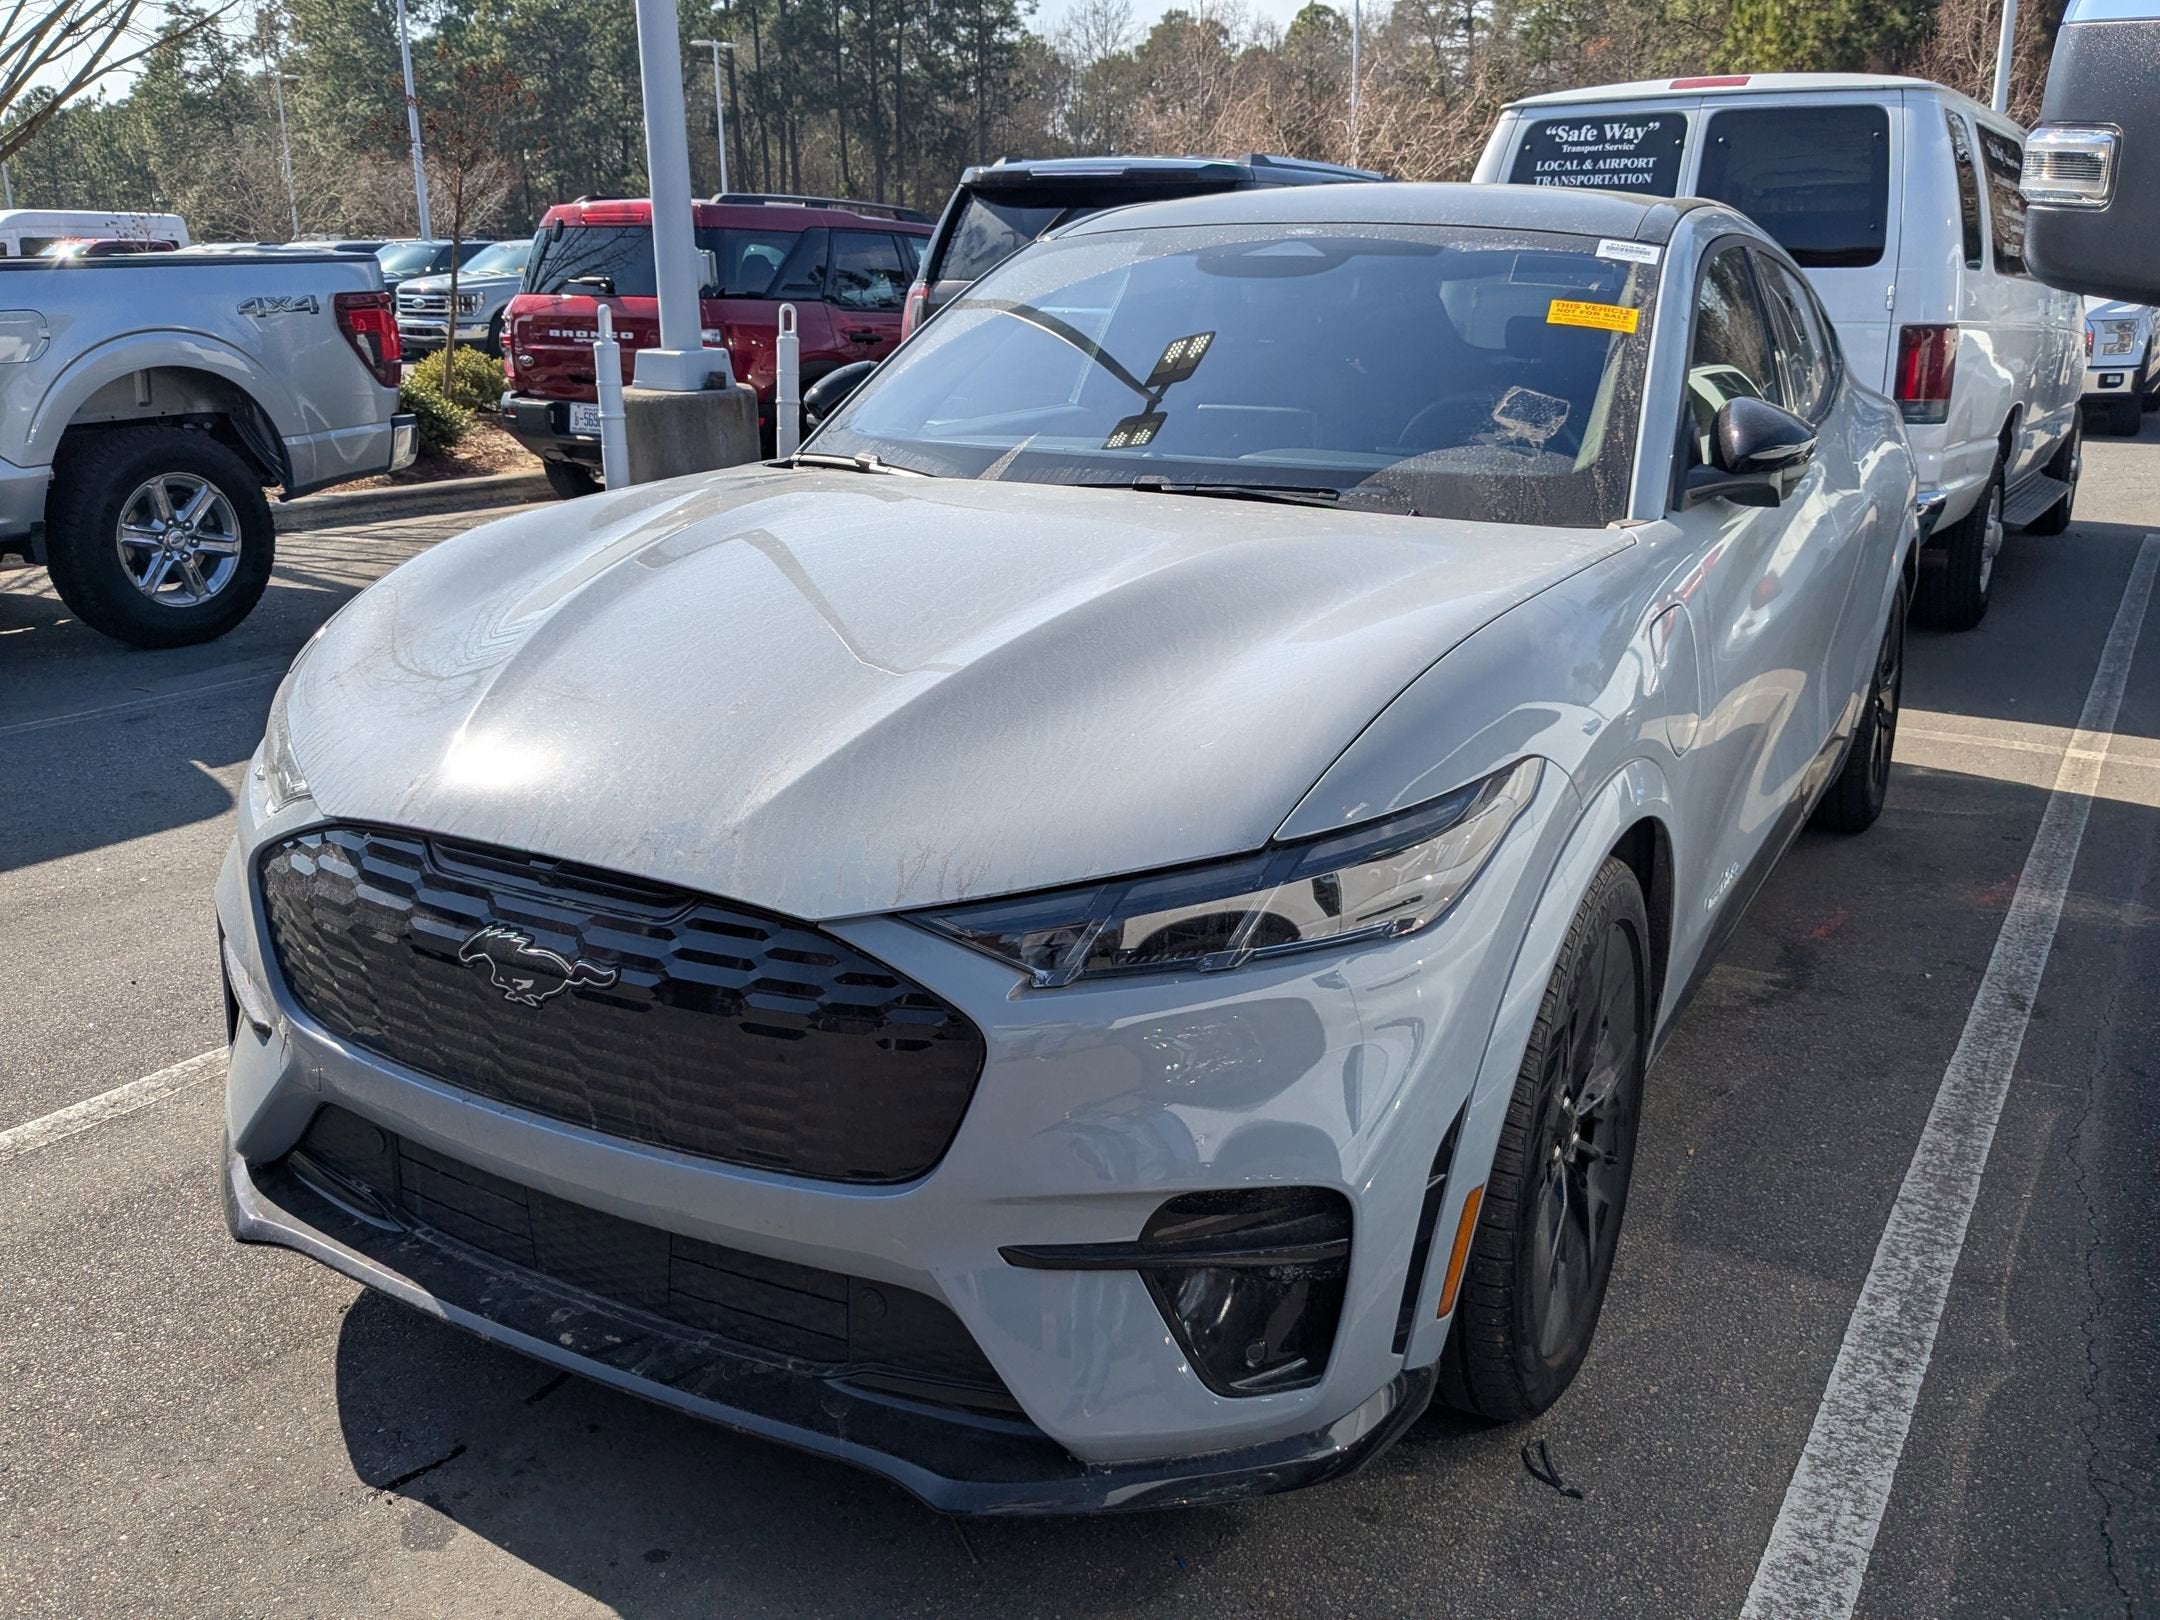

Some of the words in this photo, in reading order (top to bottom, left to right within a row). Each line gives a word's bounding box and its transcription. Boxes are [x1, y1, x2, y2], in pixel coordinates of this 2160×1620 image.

[1561, 143, 1603, 154] Transport
[1603, 142, 1636, 152] Service
[1535, 160, 1580, 172] LOCAL
[1582, 159, 1594, 170] &
[1595, 157, 1657, 170] AIRPORT
[1534, 173, 1653, 186] TRANSPORTATION
[1584, 304, 1632, 316] VEHICLE
[1603, 312, 1629, 321] SALE
